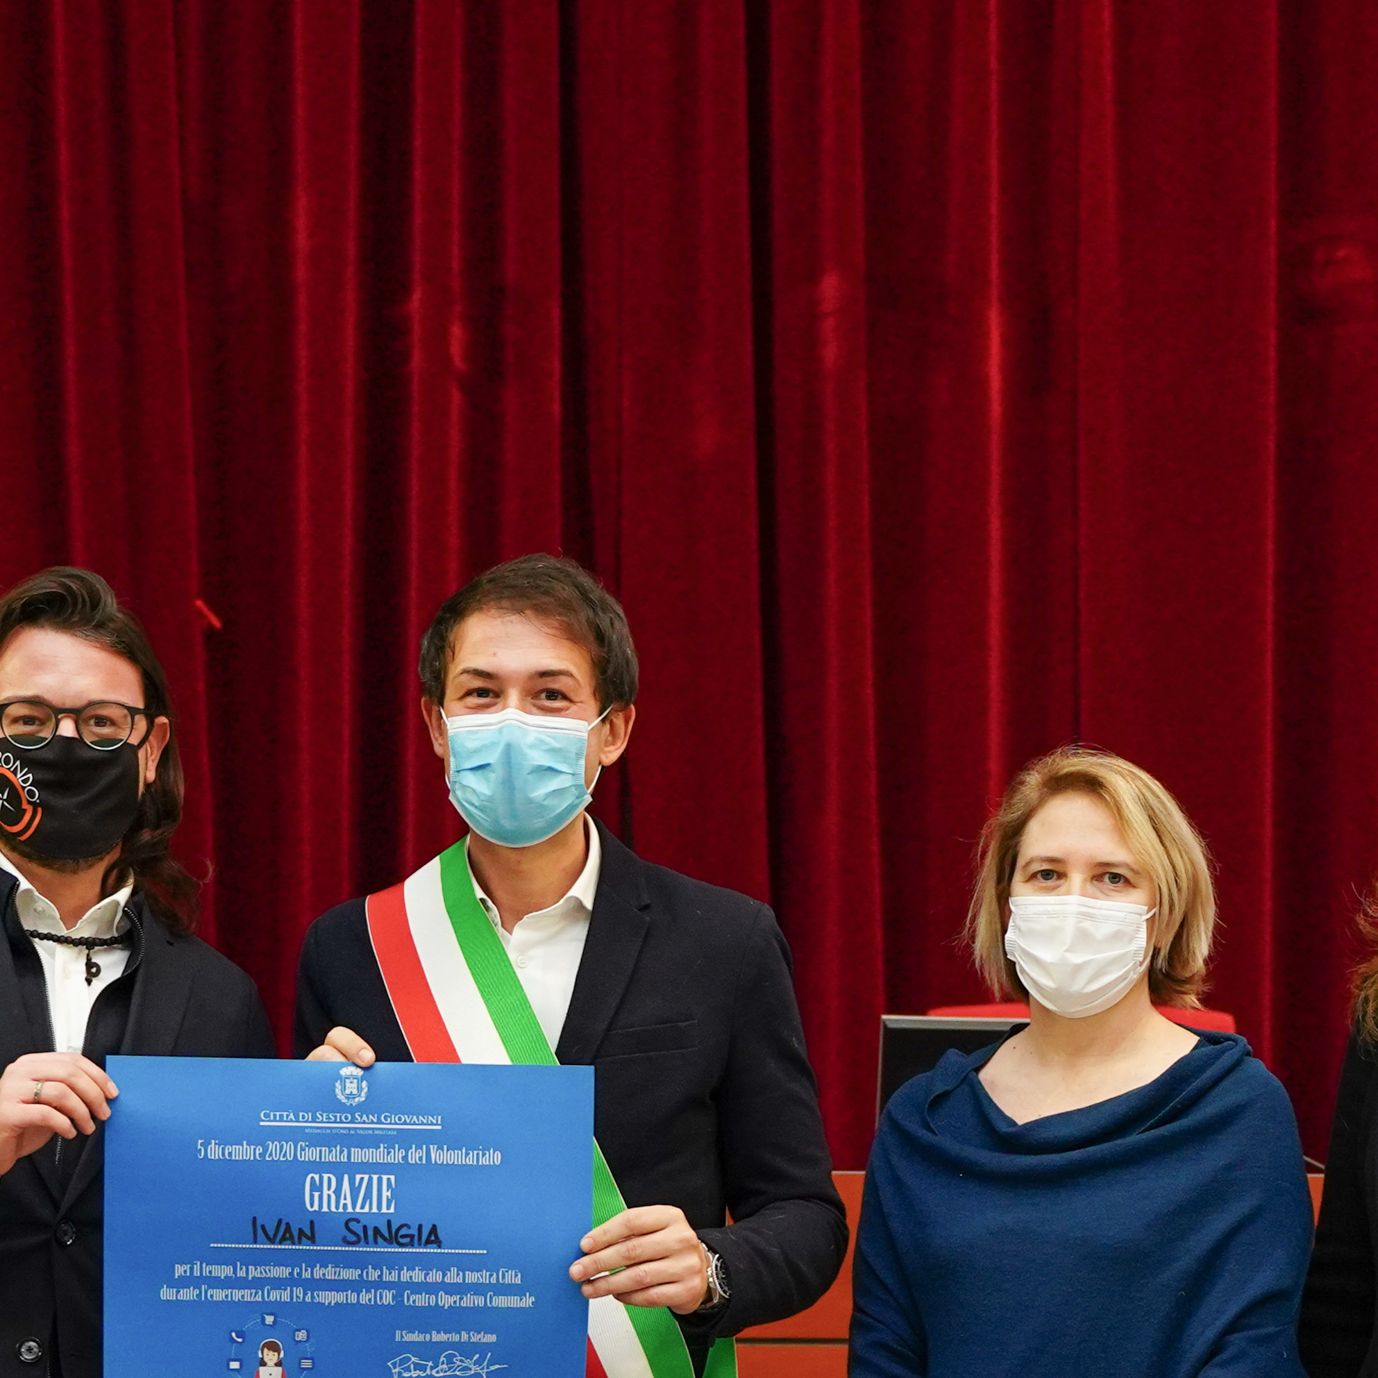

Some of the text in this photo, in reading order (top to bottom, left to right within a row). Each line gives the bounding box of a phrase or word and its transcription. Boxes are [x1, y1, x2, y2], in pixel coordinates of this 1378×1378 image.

[316, 1111, 351, 1123] SESTO
[355, 1112, 378, 1123] SAN
[381, 1113, 442, 1125] GIOVANNI
[197, 1139, 502, 1166] 5 dicembre 2020 Giornata mondiale del Volontariato
[304, 1173, 396, 1213] GRAZIE
[252, 1216, 442, 1248] IVAN SINGIA
[174, 1261, 521, 1284] per il tempo, la passione e la dedizione che hai dedicato alla nostra Città
[160, 1284, 200, 1301] durante
[264, 1286, 291, 1302] Covid
[293, 1286, 304, 1303] 19
[305, 1290, 312, 1303] a
[313, 1288, 357, 1306] supporto
[359, 1289, 375, 1305] del
[376, 1289, 396, 1305] COC
[404, 1290, 436, 1306] Centro
[438, 1291, 485, 1309] Operativo
[487, 1292, 535, 1308] Comunale
